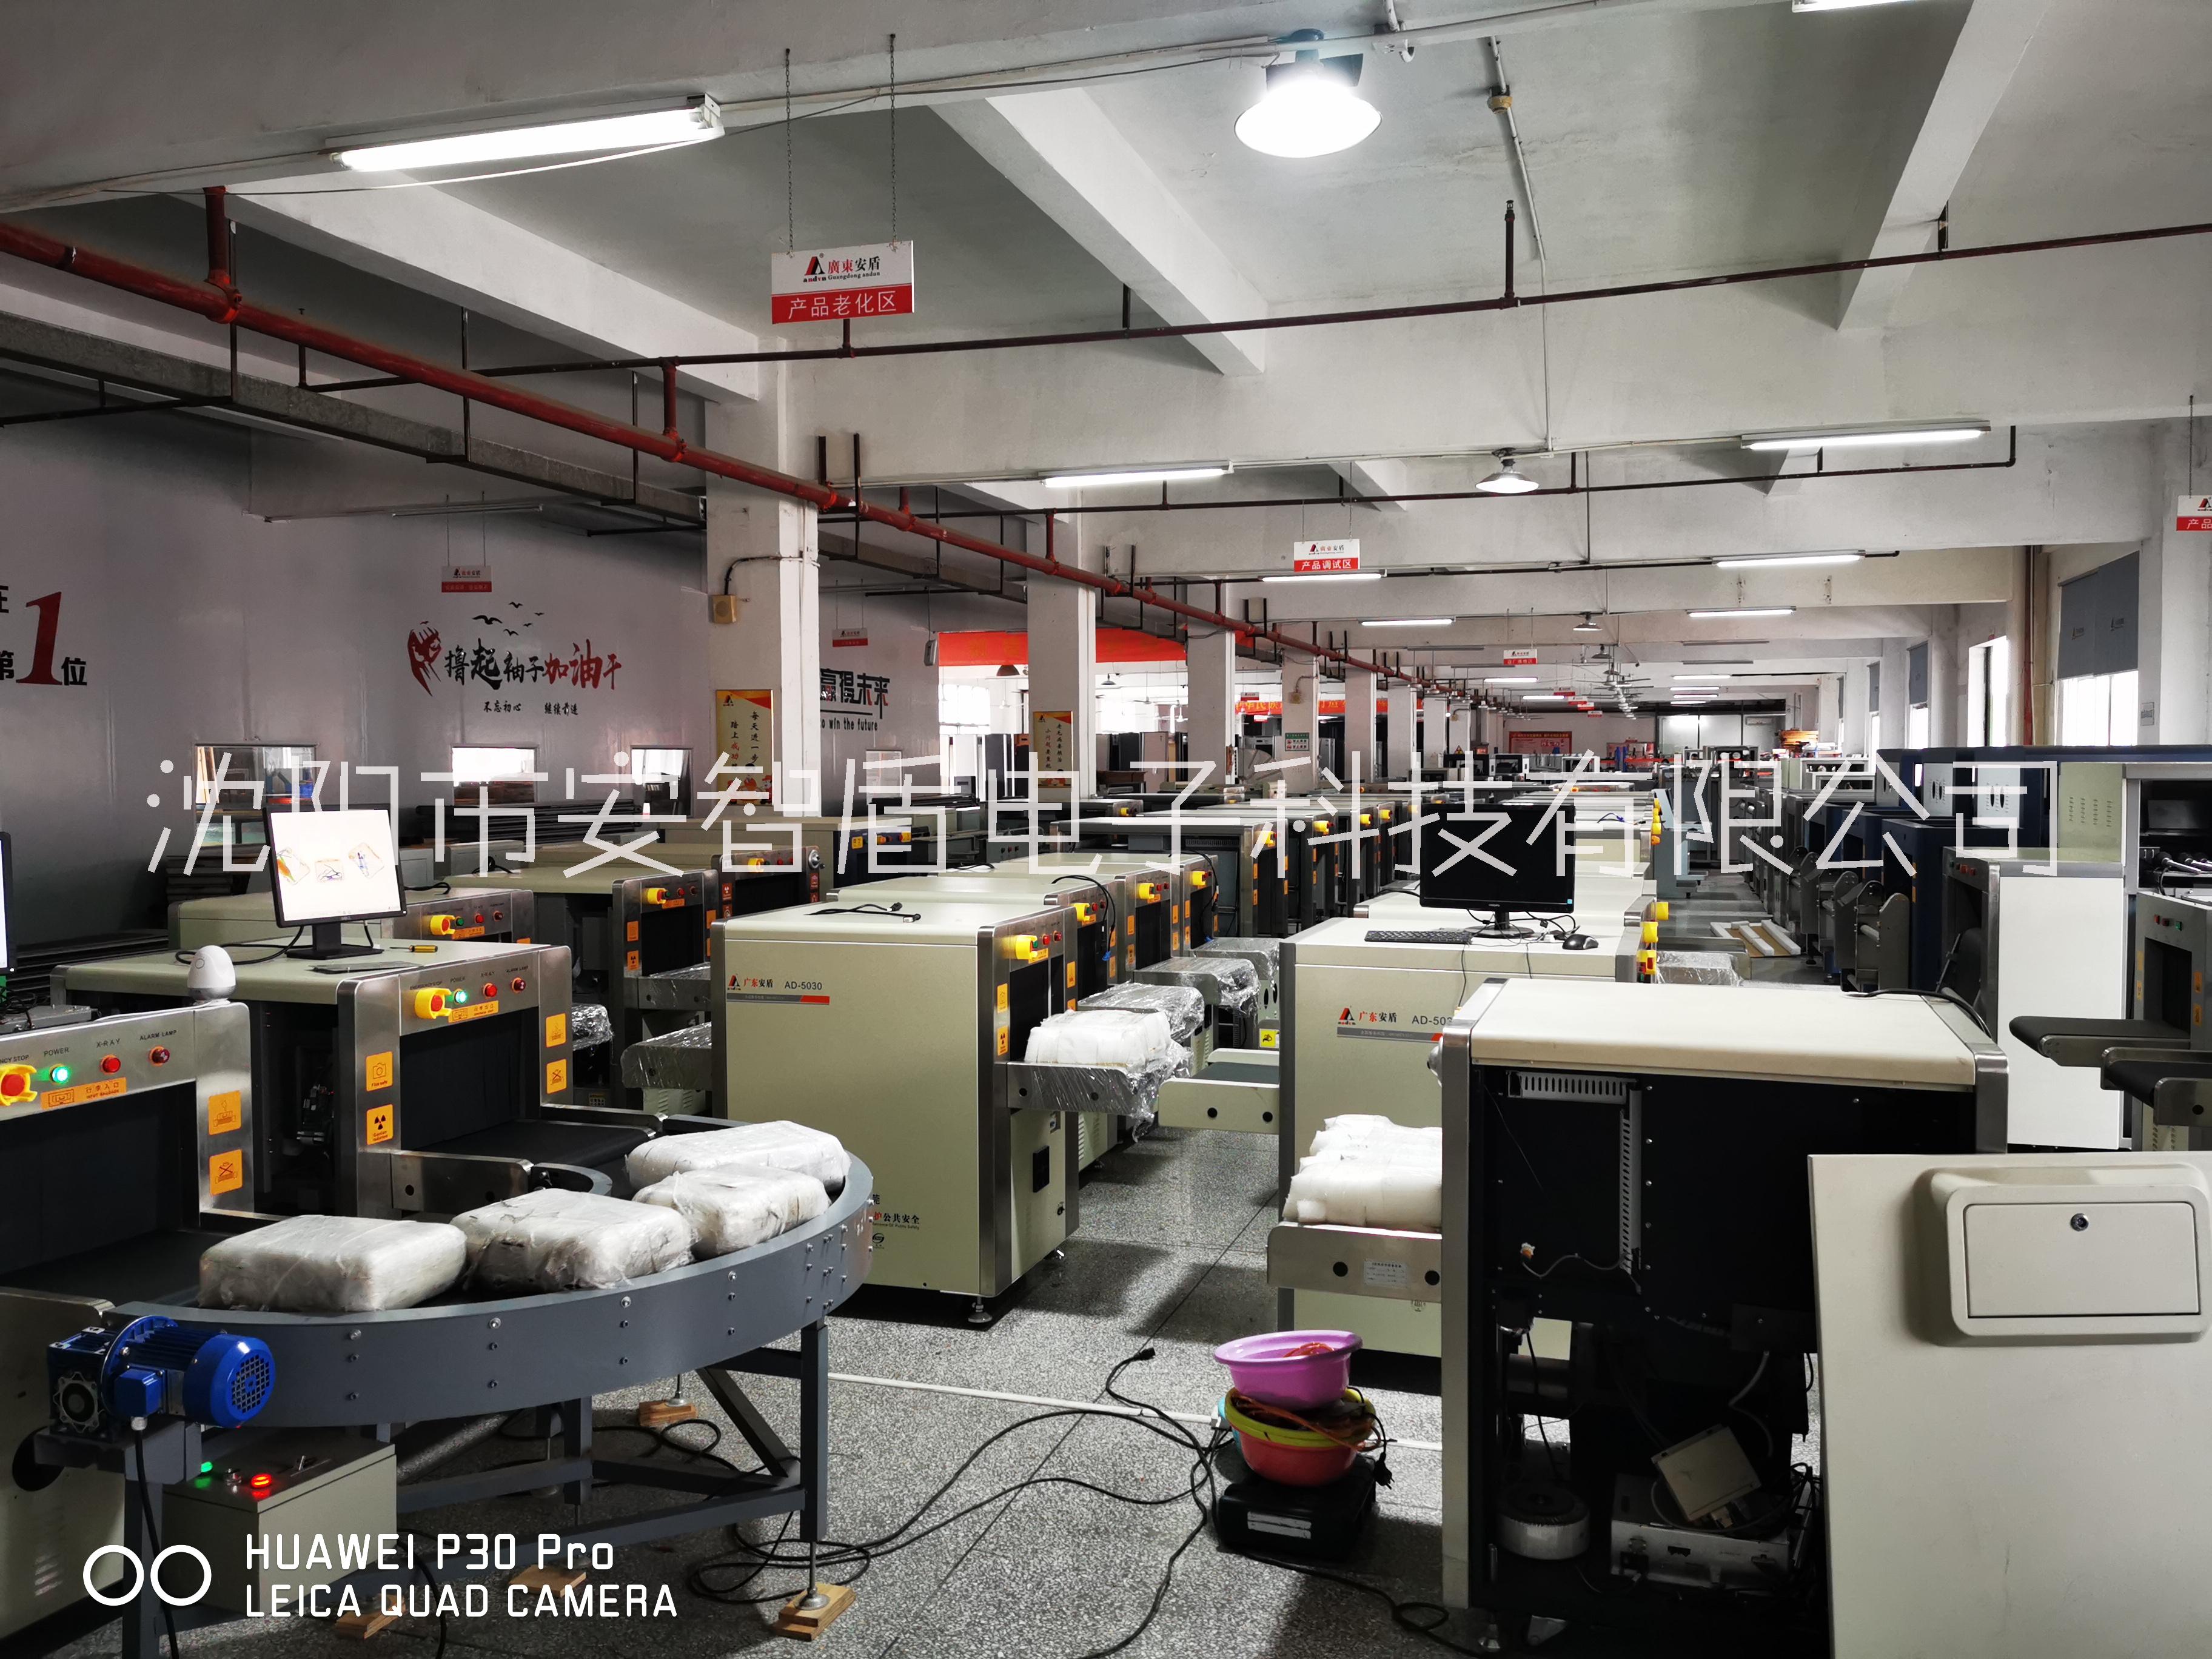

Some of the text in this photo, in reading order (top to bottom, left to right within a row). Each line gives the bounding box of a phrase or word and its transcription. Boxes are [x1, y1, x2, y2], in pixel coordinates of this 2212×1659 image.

[828, 256, 880, 273] 廣東安盾
[789, 290, 896, 320] 产品老化区
[2187, 518, 2212, 529] 产品
[1301, 559, 1352, 571] 产品调试区
[444, 638, 622, 690] 撸起袖子加油干
[820, 668, 890, 719] 赢得未来
[484, 700, 521, 713] 不忘初心
[829, 717, 840, 729] win
[843, 717, 854, 730] the
[858, 718, 877, 731] future
[743, 977, 822, 990] 广东安盾 AD-5030
[1359, 1011, 1397, 1022] 广东安盾
[44, 1047, 69, 1057] POWER
